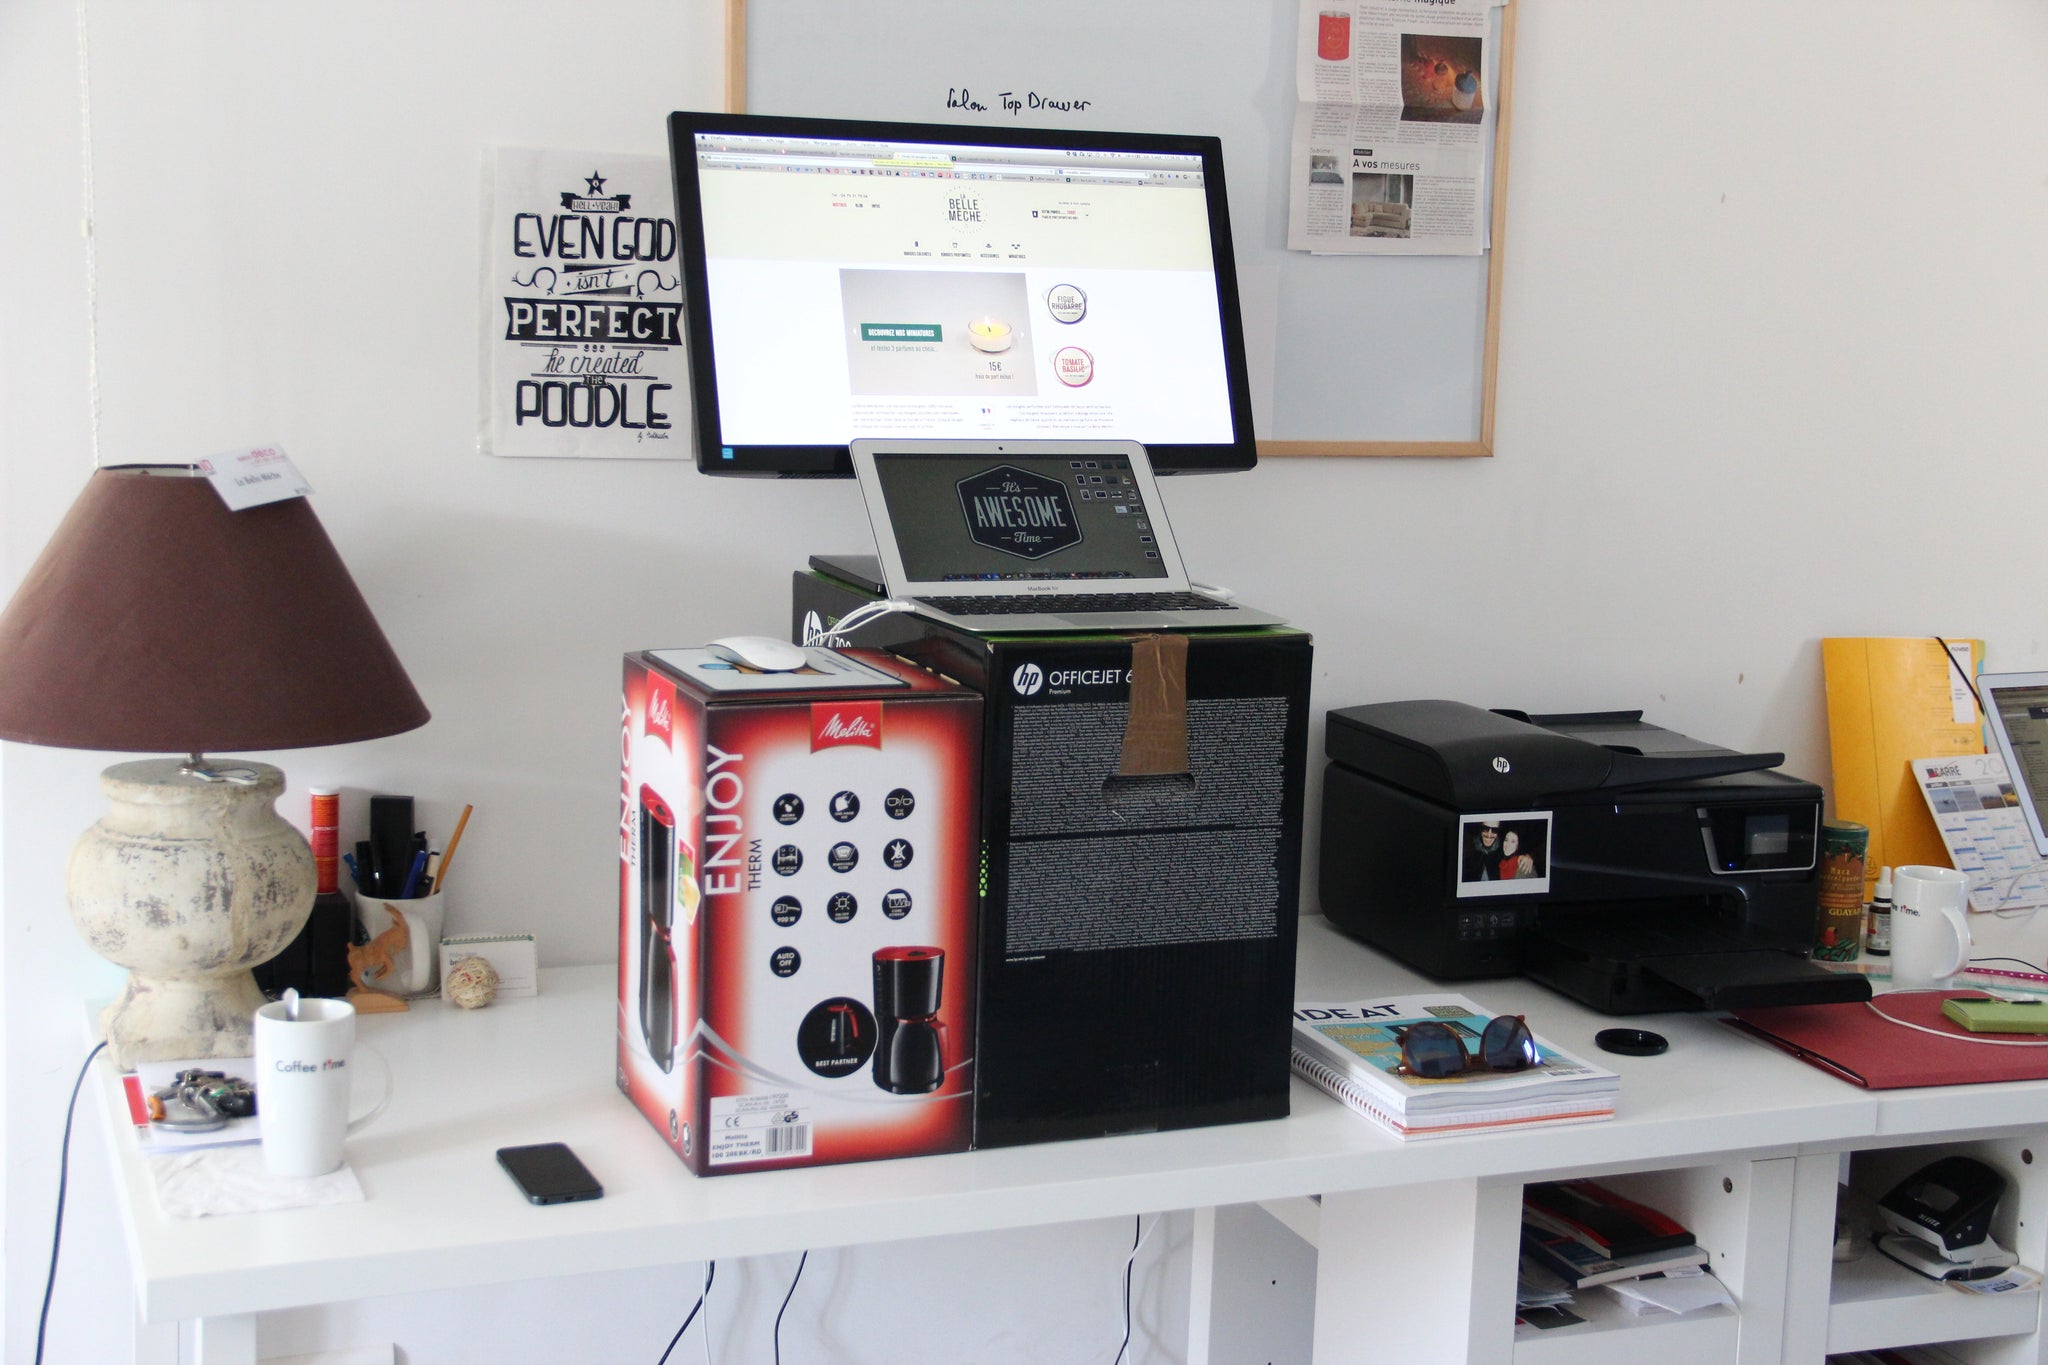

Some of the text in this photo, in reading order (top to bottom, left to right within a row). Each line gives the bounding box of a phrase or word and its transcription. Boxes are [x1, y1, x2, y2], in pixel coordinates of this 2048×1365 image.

[947, 88, 1092, 116] Salon Top Drawer
[1362, 160, 1378, 169] vos
[1380, 161, 1421, 171] mesures
[948, 198, 980, 210] BELLE
[514, 212, 676, 262] EVEN GOD
[511, 302, 676, 340] PERFECT
[543, 347, 644, 375] he created
[1062, 358, 1084, 366] TOMATE
[515, 379, 672, 430] POODLE
[1001, 481, 1021, 494] It's
[973, 495, 1067, 529] AWESOME
[1014, 531, 1042, 545] Time
[1014, 663, 1042, 695] hp
[1049, 669, 1122, 686] OFFICEJET
[1493, 756, 1510, 774] hp
[619, 694, 632, 865] ENJOY
[704, 744, 744, 896] ENJOY
[748, 838, 763, 892] THERM
[777, 952, 795, 960] AUTO
[779, 959, 792, 967] OFF
[1294, 1004, 1401, 1022] IDEAT
[275, 1058, 317, 1073] Coffee
